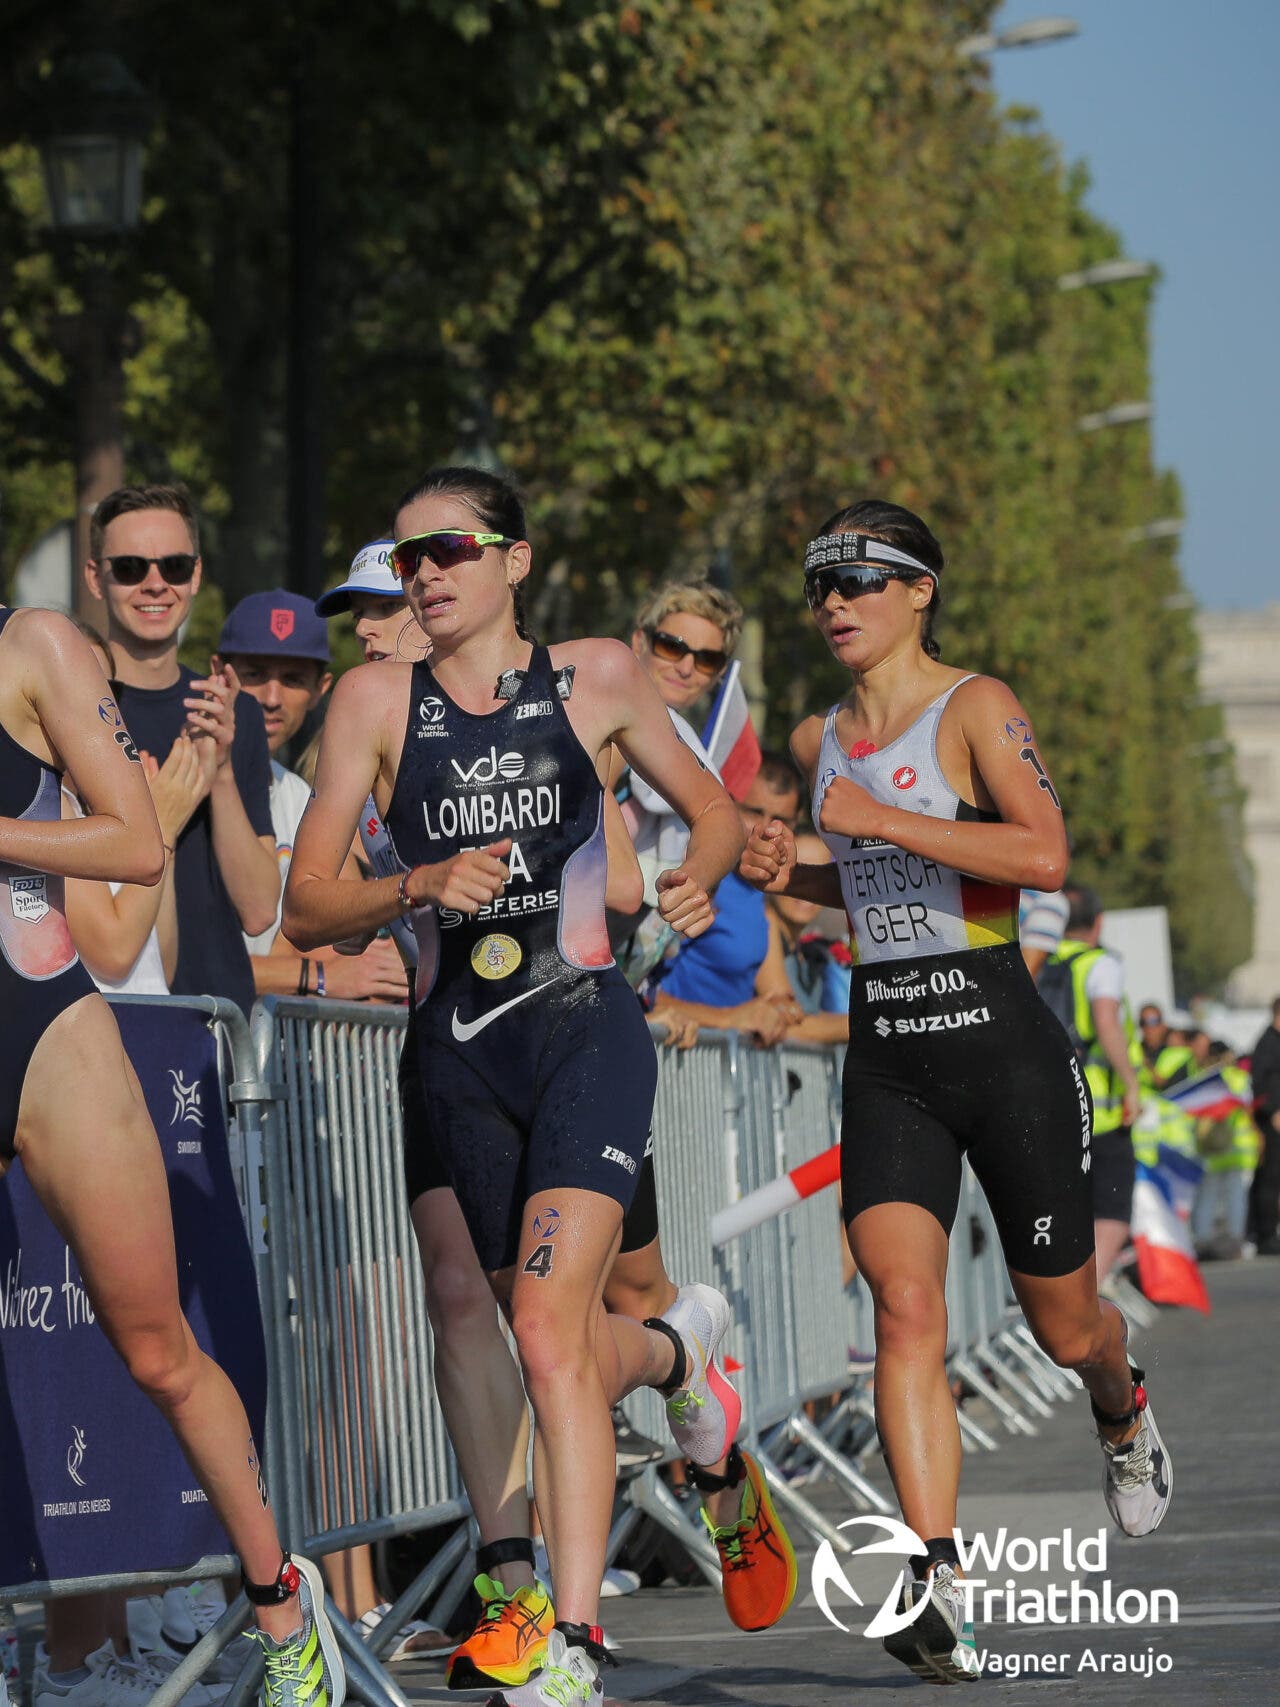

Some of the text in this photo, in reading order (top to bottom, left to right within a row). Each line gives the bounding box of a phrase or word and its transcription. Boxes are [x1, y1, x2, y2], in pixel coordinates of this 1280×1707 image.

[416, 730, 449, 739] Triathlon
[421, 723, 445, 732] World
[113, 729, 144, 764] 2
[422, 783, 561, 841] LOMBARDI
[15, 879, 34, 892] FDJ
[843, 853, 942, 898] TERTSCH
[15, 893, 45, 907] Sport
[19, 903, 45, 913] Factory
[865, 901, 937, 944] GER
[865, 978, 927, 1003] Bitburger
[894, 1006, 991, 1034] SUZUKI
[1069, 1056, 1091, 1149] SUZUKI
[522, 1242, 555, 1280] 4
[43, 1498, 111, 1517] TRIATHLON DES NEIGES
